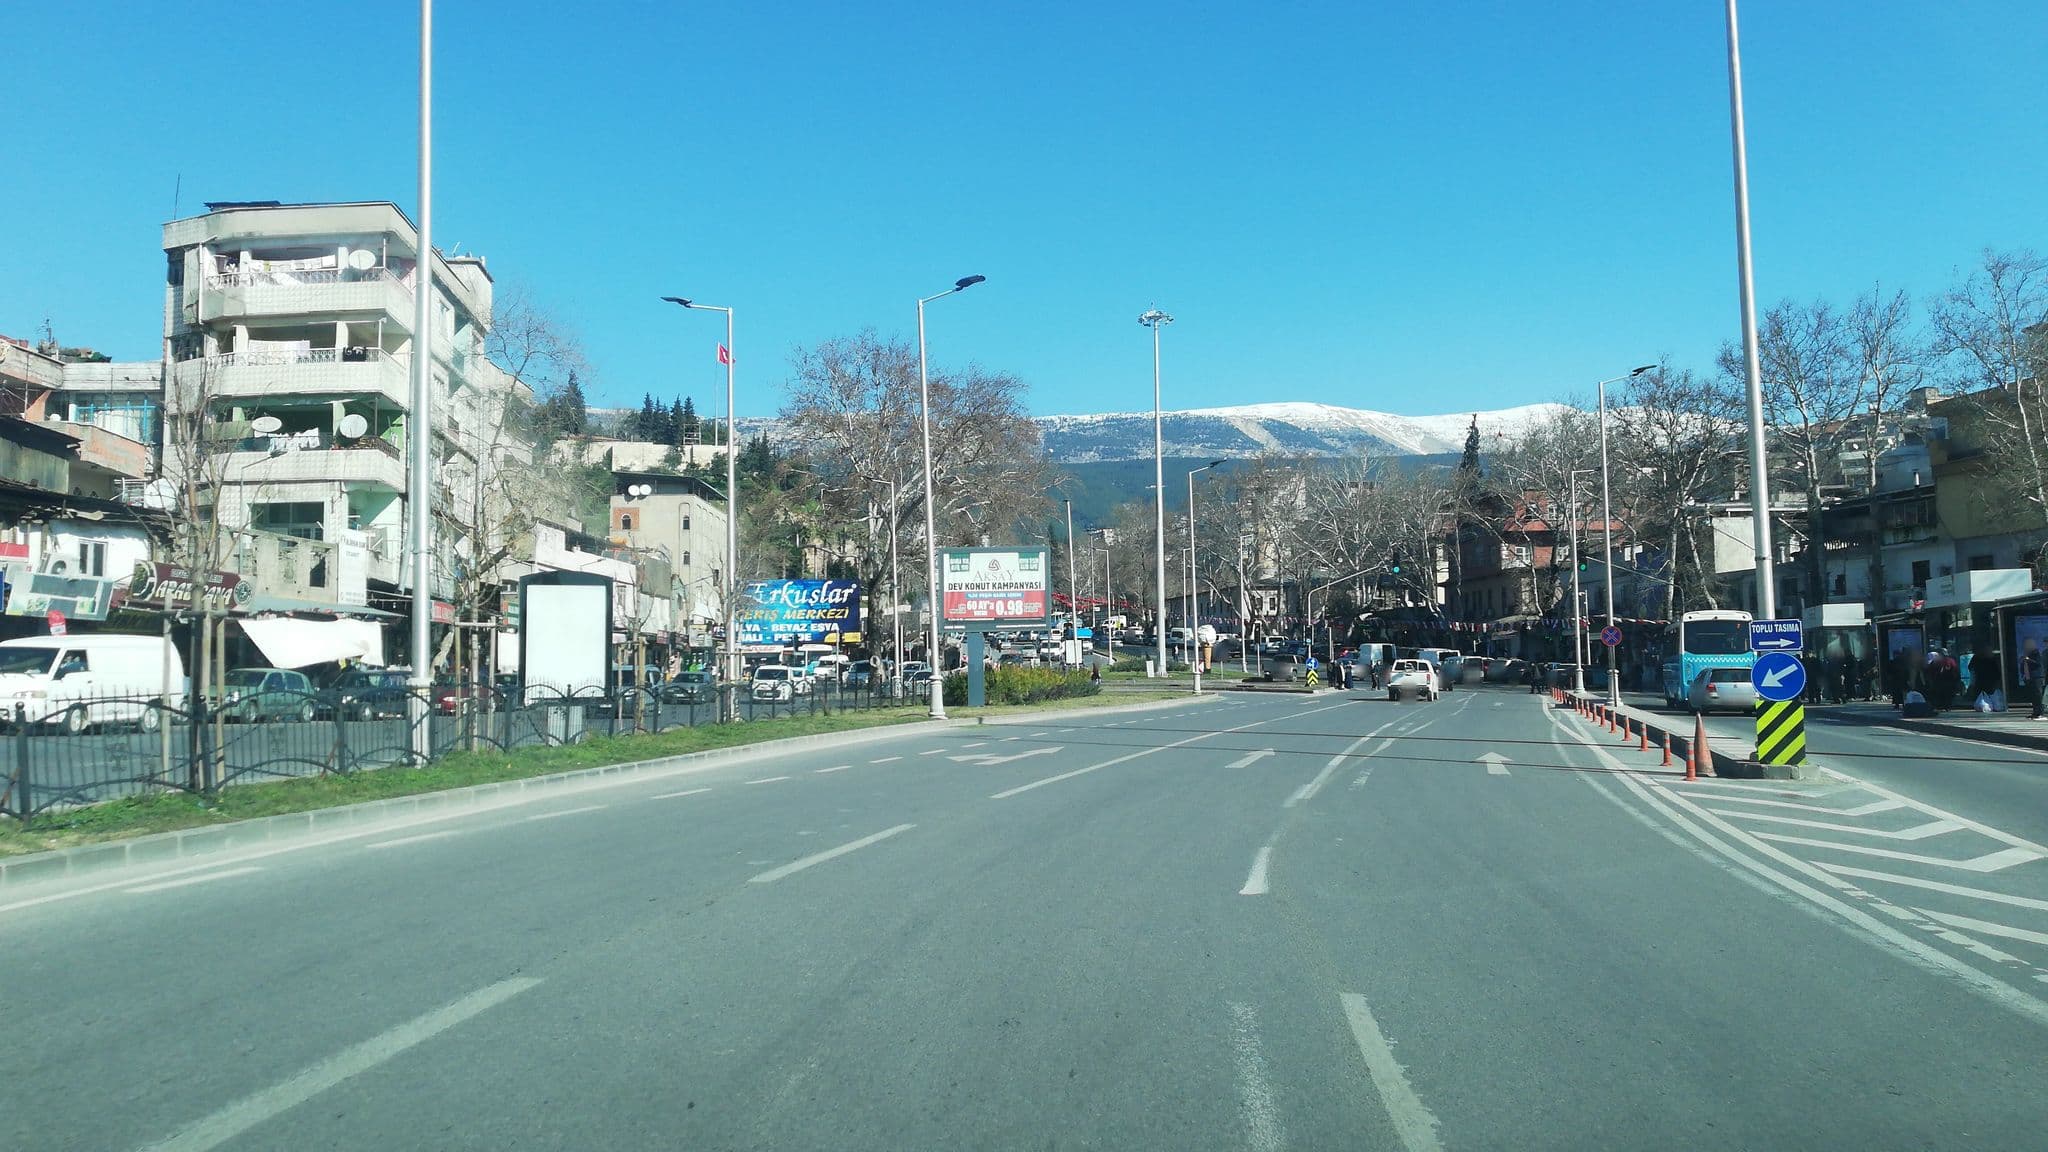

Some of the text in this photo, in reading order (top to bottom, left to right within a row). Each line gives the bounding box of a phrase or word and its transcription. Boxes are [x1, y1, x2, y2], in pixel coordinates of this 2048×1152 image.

[965, 582, 990, 590] KONUT
[992, 581, 1041, 590] KAMPANYASI
[966, 600, 977, 610] 60
[995, 599, 1023, 616] 0.98
[783, 607, 849, 619] MERKEZİ
[772, 623, 807, 632] BEYAZ
[1751, 624, 1773, 633] TOPLU
